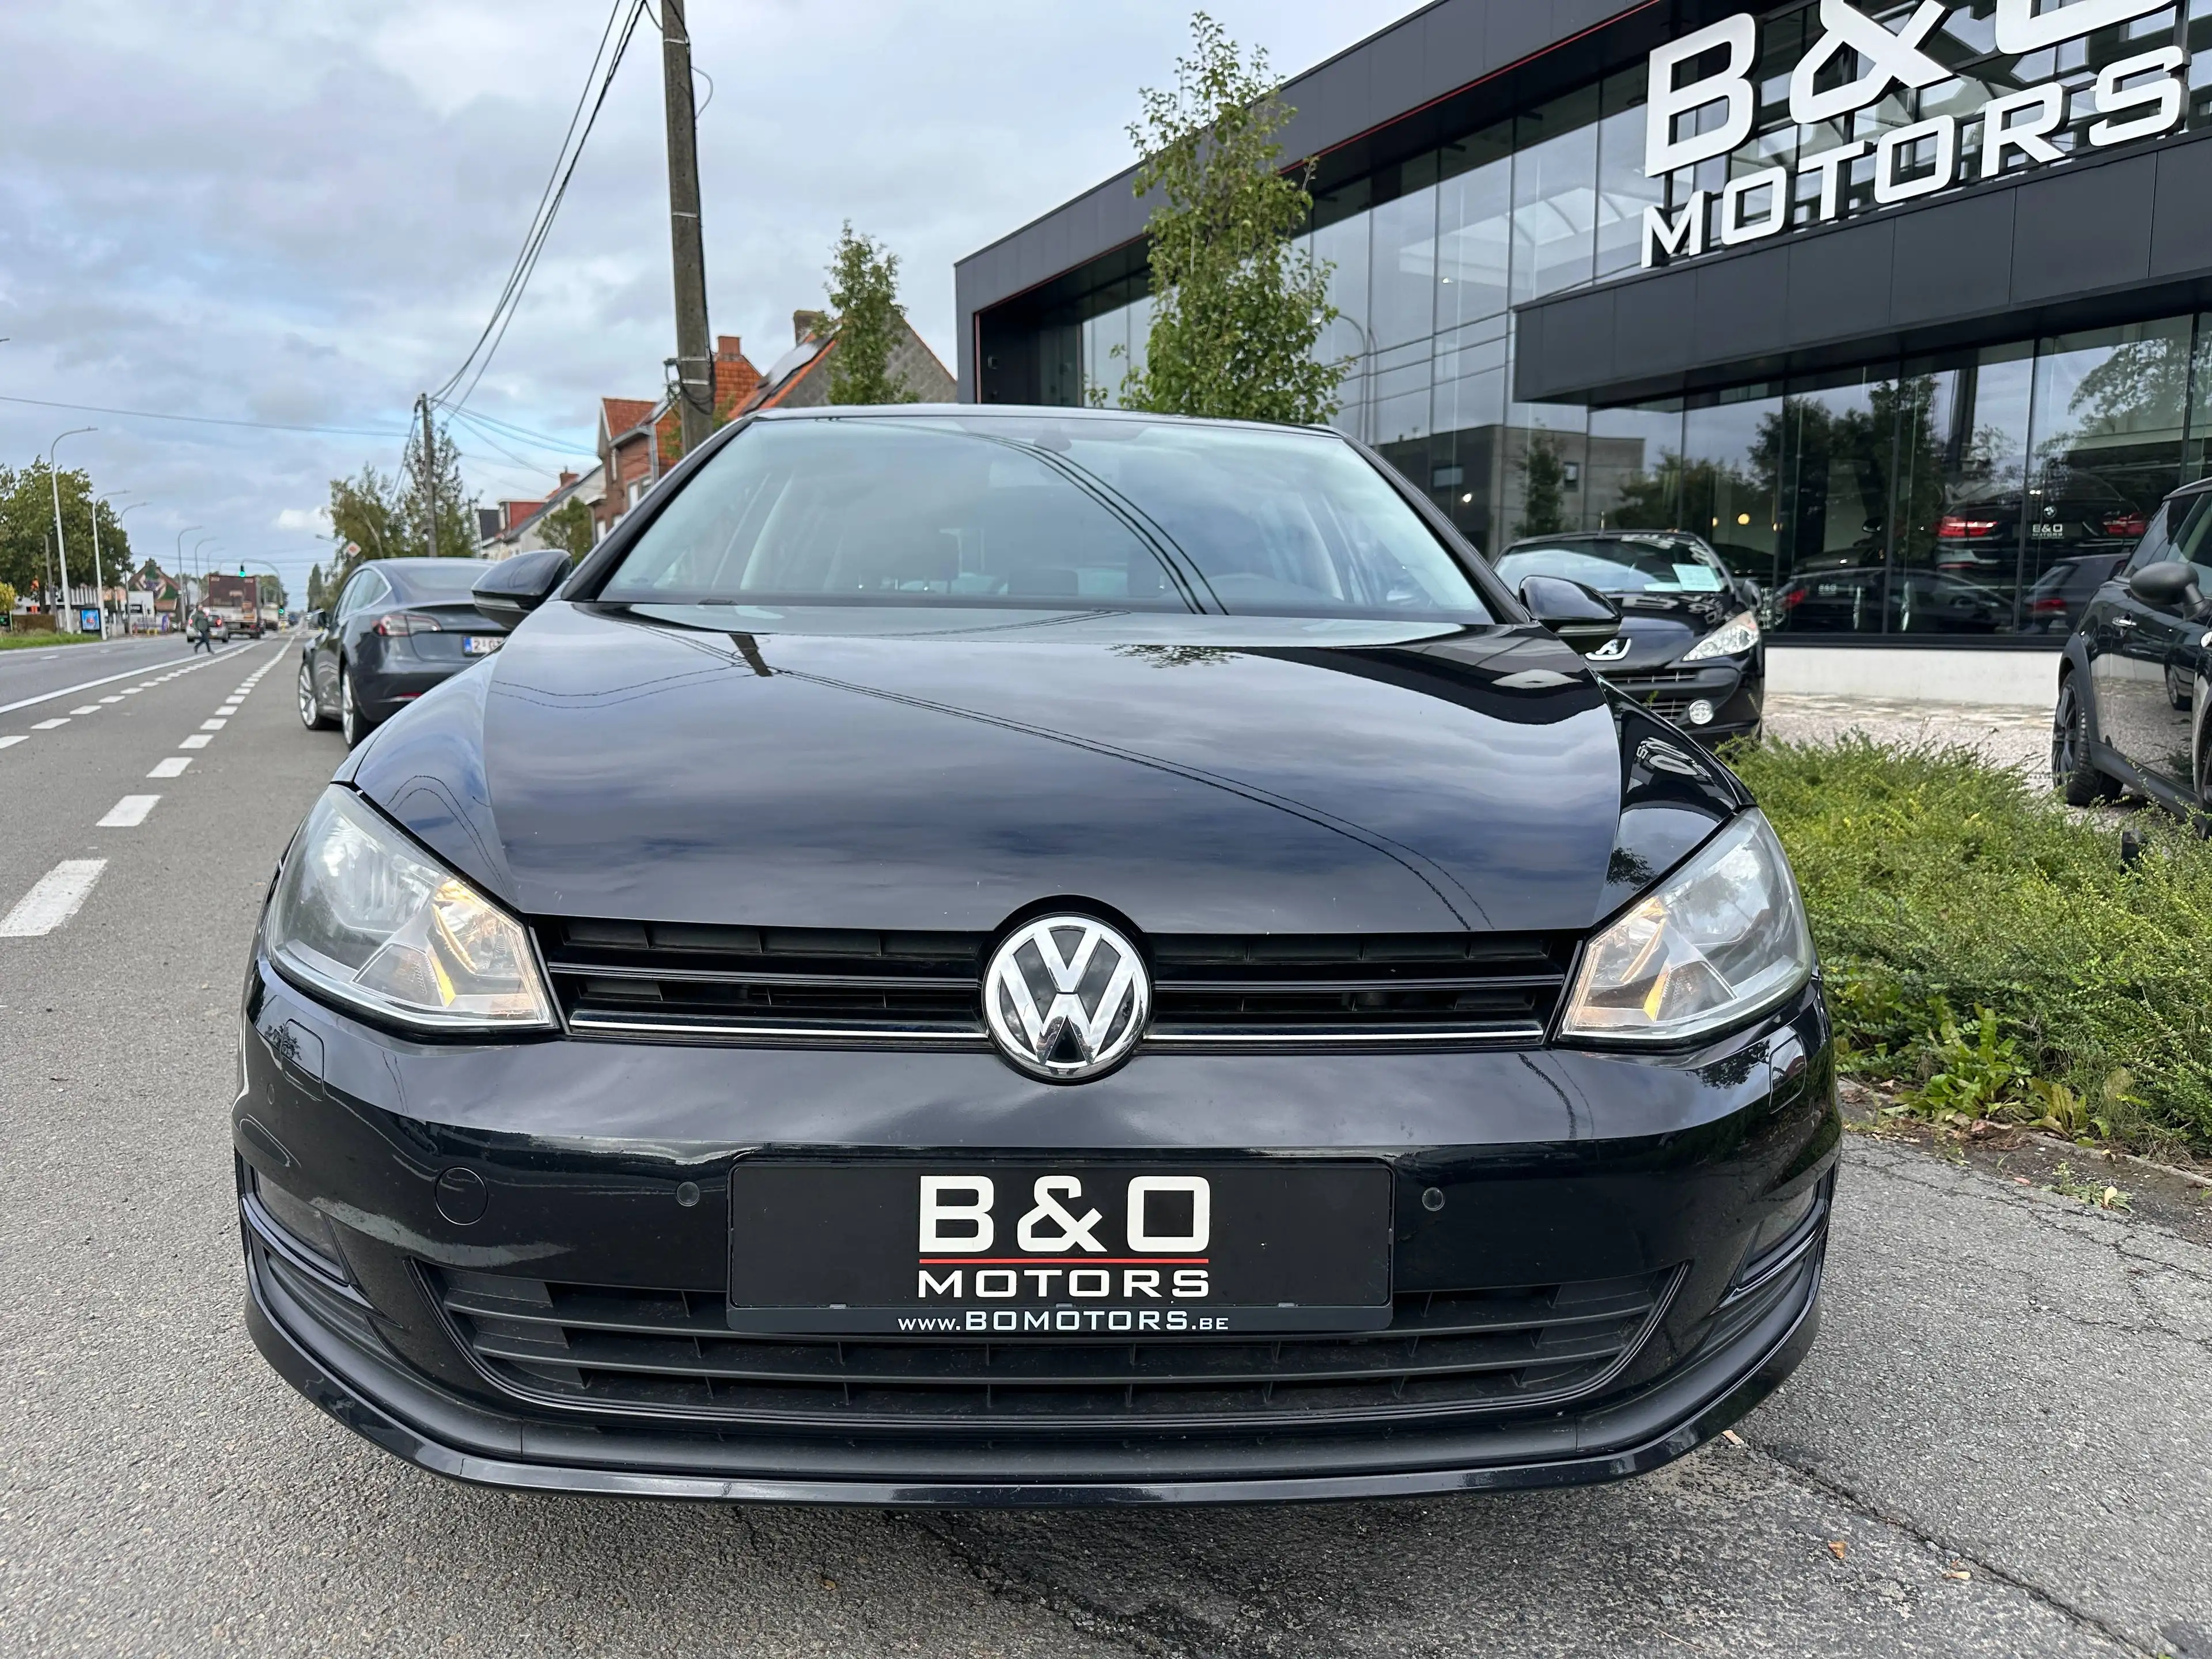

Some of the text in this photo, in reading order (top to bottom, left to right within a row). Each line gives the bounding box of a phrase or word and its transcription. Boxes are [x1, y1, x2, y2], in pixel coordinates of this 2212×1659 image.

[1641, 46, 2183, 268] MOTORS
[919, 1176, 1210, 1252] B&O
[918, 1270, 1209, 1298] MOTORS
